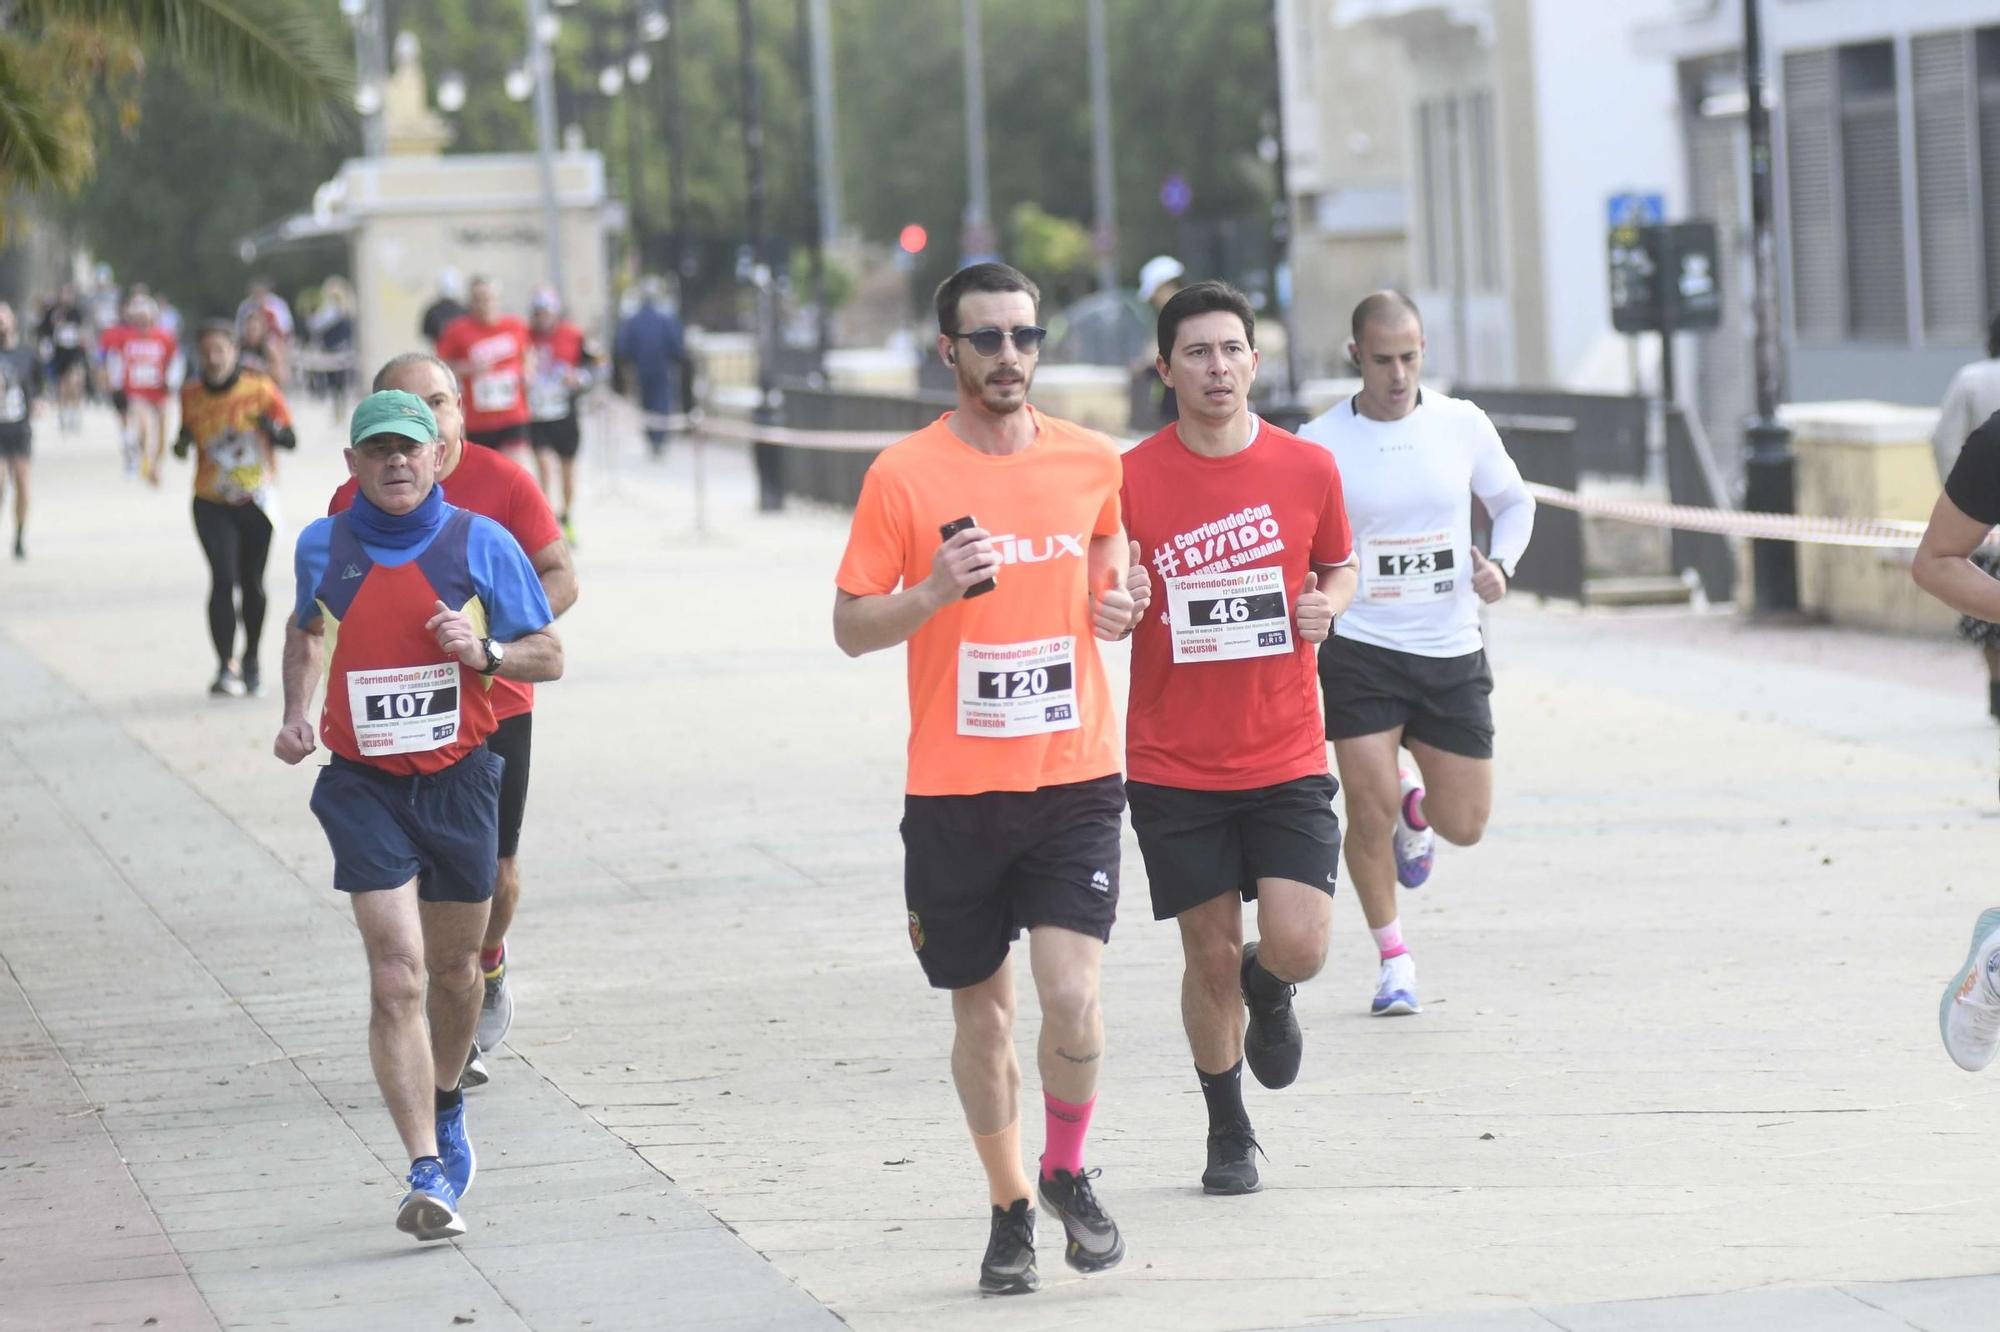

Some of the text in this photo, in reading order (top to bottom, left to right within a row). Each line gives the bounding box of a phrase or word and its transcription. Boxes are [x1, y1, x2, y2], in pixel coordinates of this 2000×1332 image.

[1174, 503, 1272, 550] CorriendoCon
[1231, 539, 1285, 567] SOLIDARIA
[1388, 553, 1436, 575] 123
[1209, 598, 1249, 623] 46
[1181, 644, 1218, 654] INCLUSIÓN
[991, 669, 1048, 698] 120
[377, 692, 434, 719] 107
[966, 718, 1006, 728] INCLUSIÓN
